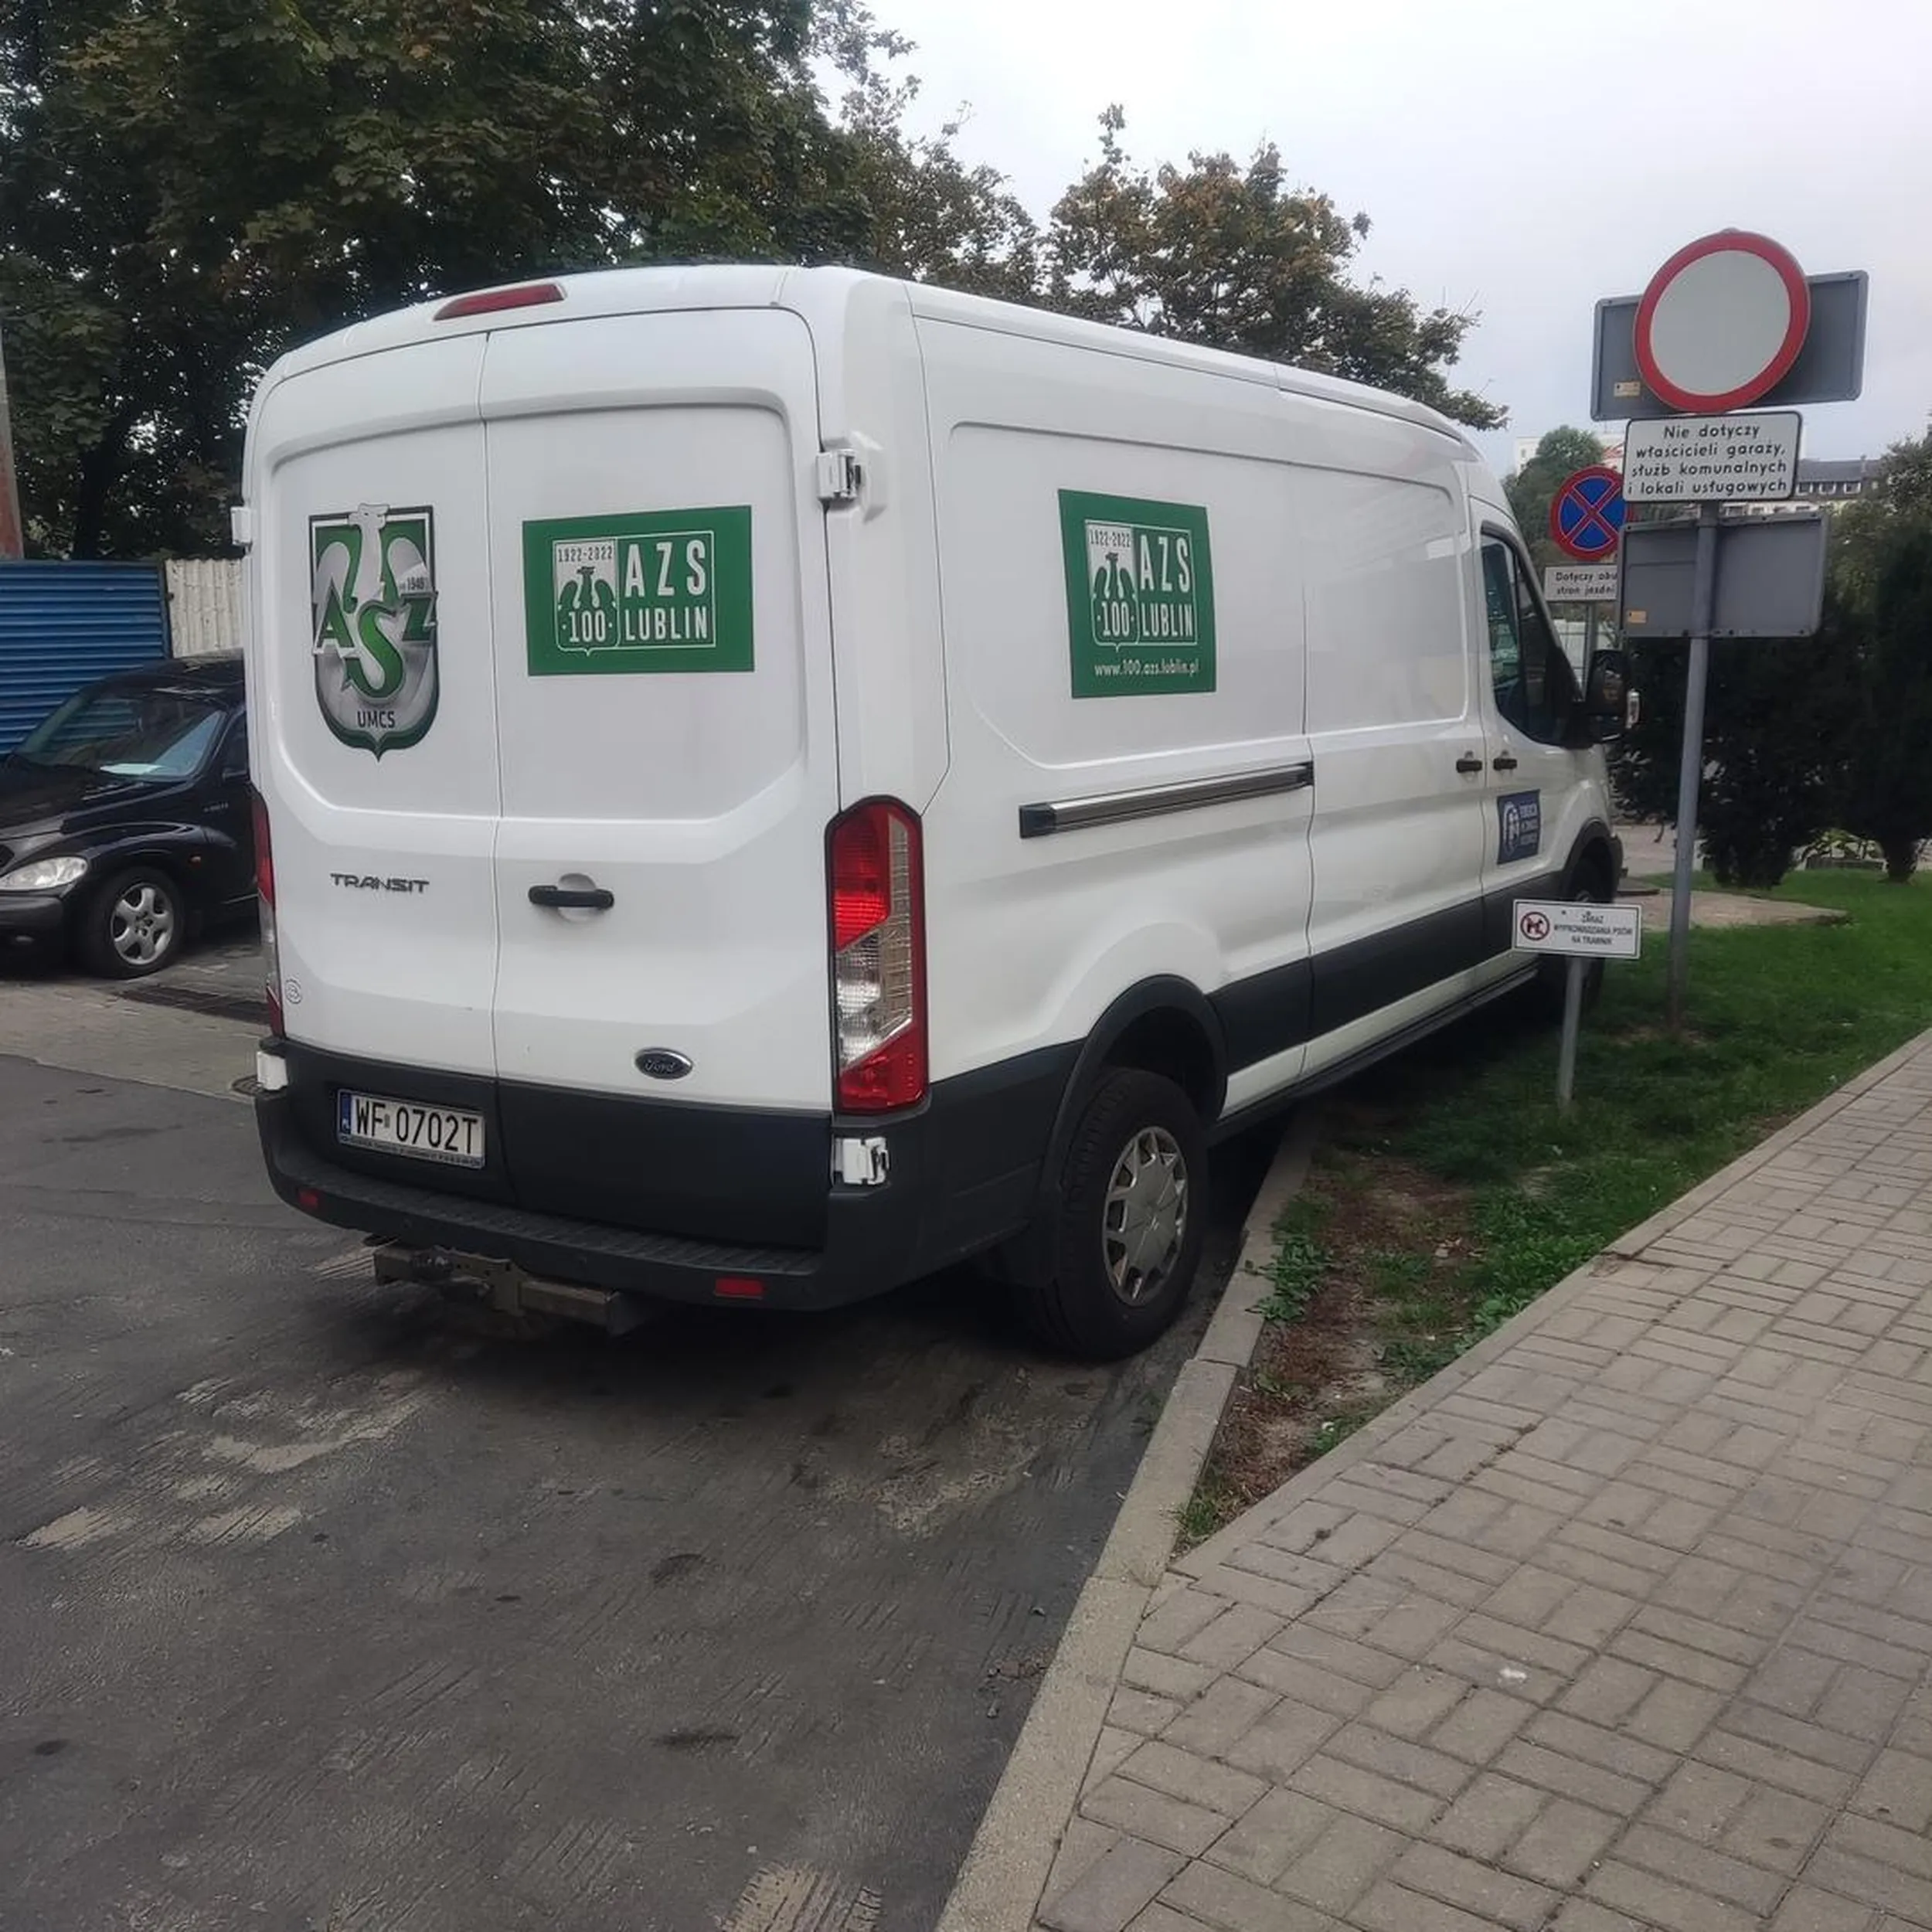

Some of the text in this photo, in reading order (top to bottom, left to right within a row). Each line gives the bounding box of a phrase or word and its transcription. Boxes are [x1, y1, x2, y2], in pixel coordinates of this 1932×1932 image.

[1664, 423, 1760, 439] Nie dotyczy
[1636, 442, 1719, 458] właścicieli
[1631, 459, 1787, 478] służb komunalnych
[1641, 481, 1684, 495] lokali
[1692, 479, 1787, 496] usługowych
[558, 546, 613, 563] 1922-2022
[1140, 534, 1191, 592] AZS
[624, 539, 706, 597] AZS
[1556, 573, 1594, 583] Dotyczy
[624, 606, 707, 641] LUBLIN
[1141, 603, 1192, 636] LUBLIN
[357, 711, 396, 728] UMCS
[330, 873, 430, 893] TRANSIT
[356, 1099, 386, 1136] WF
[396, 1106, 478, 1155] 0702T
